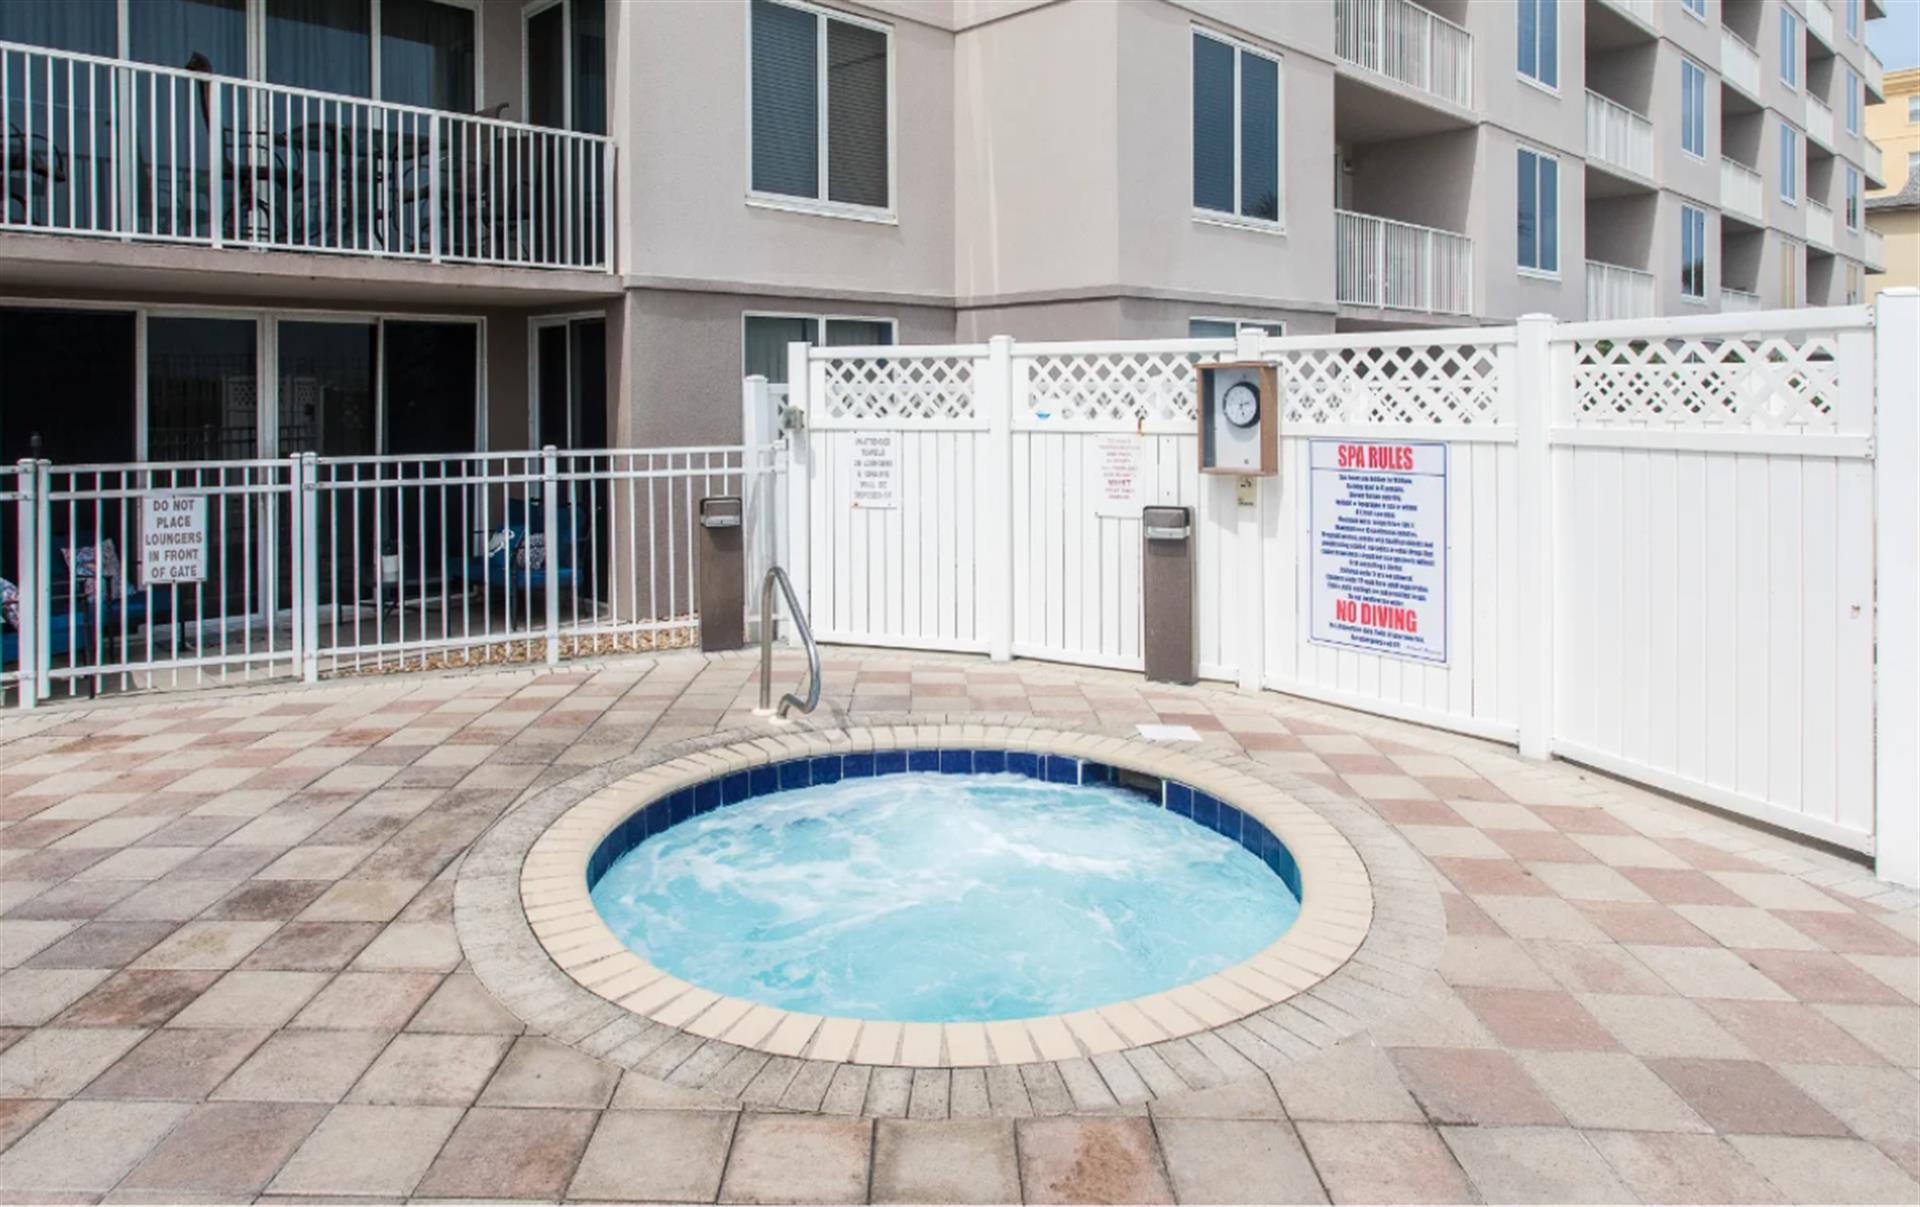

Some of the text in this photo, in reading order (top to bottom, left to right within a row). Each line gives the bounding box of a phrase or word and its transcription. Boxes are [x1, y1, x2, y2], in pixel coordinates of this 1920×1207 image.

[1338, 444, 1413, 471] SPA RULES
[153, 499, 195, 512] DO NOT
[156, 515, 191, 529] PLACE
[145, 531, 203, 546] LOUNGERS
[149, 548, 199, 563] IN FRONT
[151, 565, 197, 578] OF GATE
[1336, 599, 1357, 623] NO
[1361, 602, 1417, 633] DIVING
